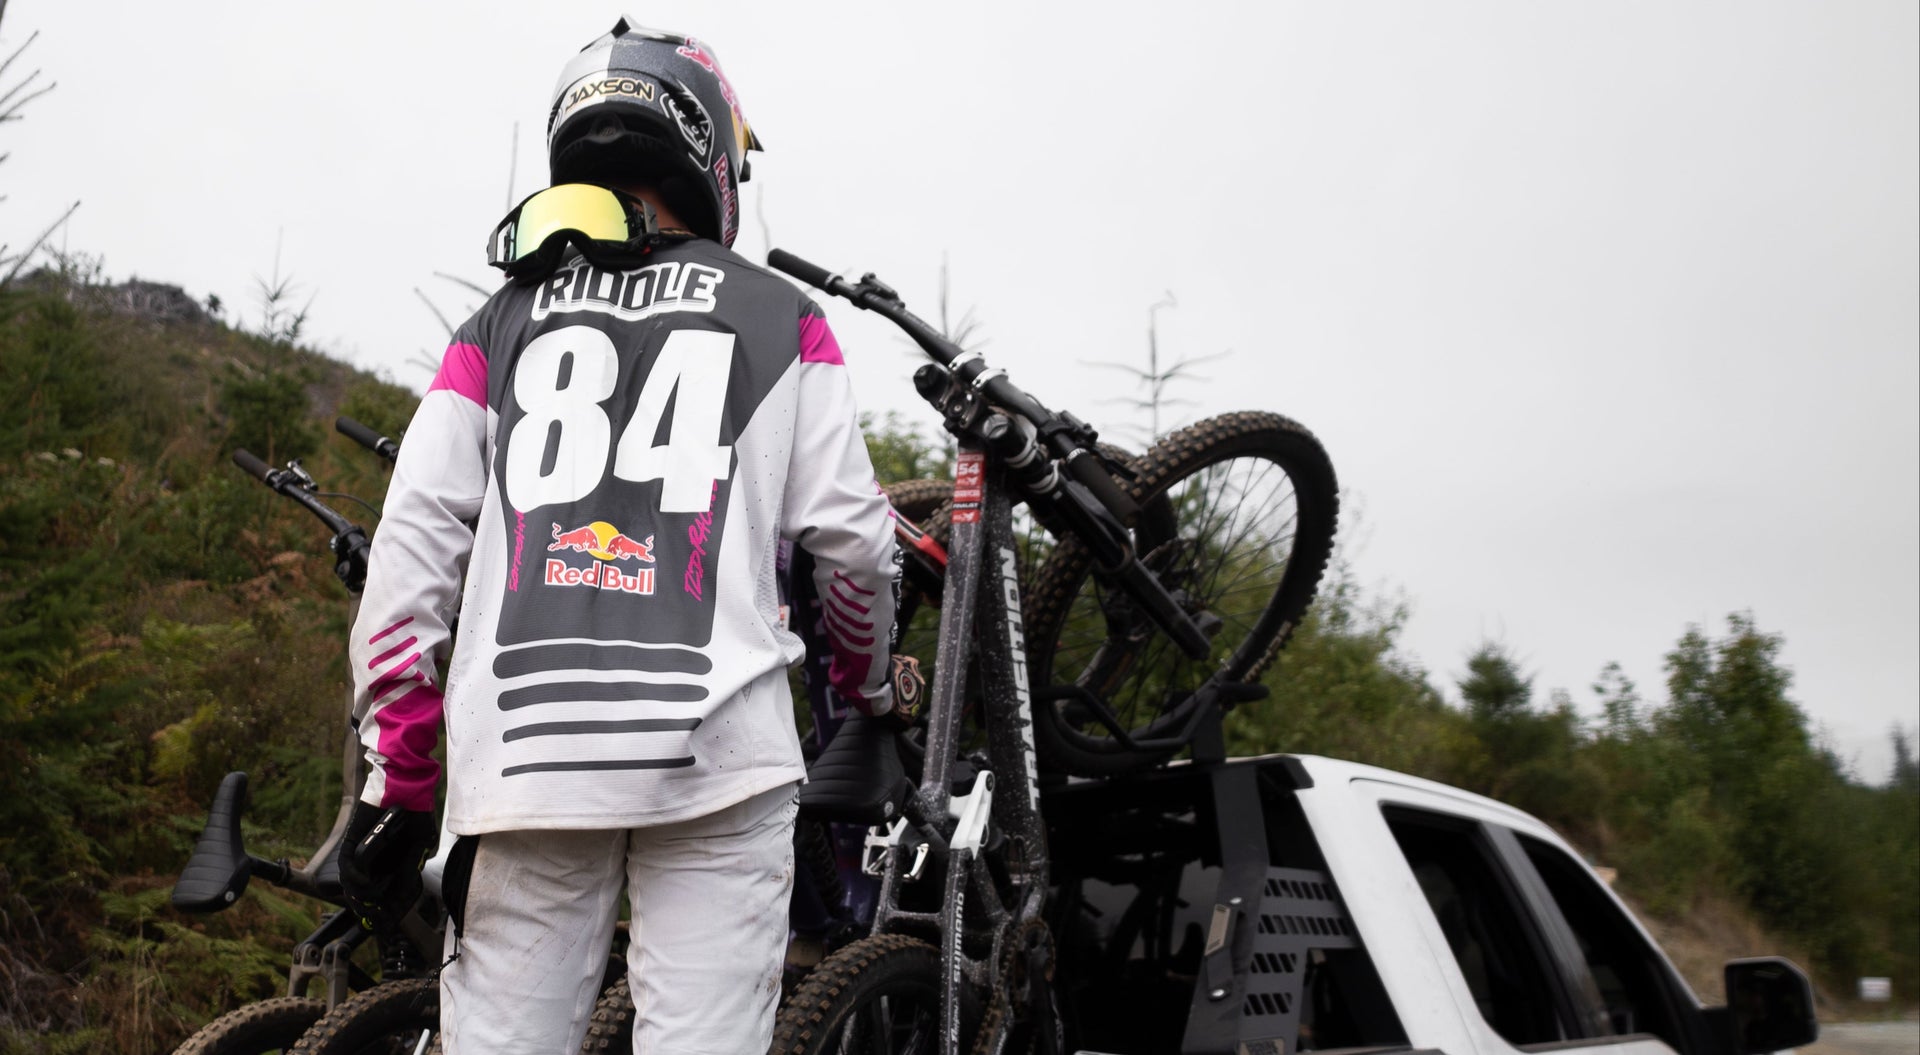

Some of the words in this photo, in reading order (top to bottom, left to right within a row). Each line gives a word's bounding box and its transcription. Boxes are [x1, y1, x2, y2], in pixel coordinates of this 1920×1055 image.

[565, 77, 654, 112] JAXSON
[713, 152, 736, 205] Red
[723, 200, 738, 249] Bull
[532, 262, 725, 321] RIDDLE
[506, 325, 736, 513] 84
[958, 463, 980, 475] 54
[545, 559, 601, 589] Red
[602, 563, 655, 595] Bull
[999, 547, 1041, 811] TRANSITION
[953, 892, 965, 984] SHIMANO
